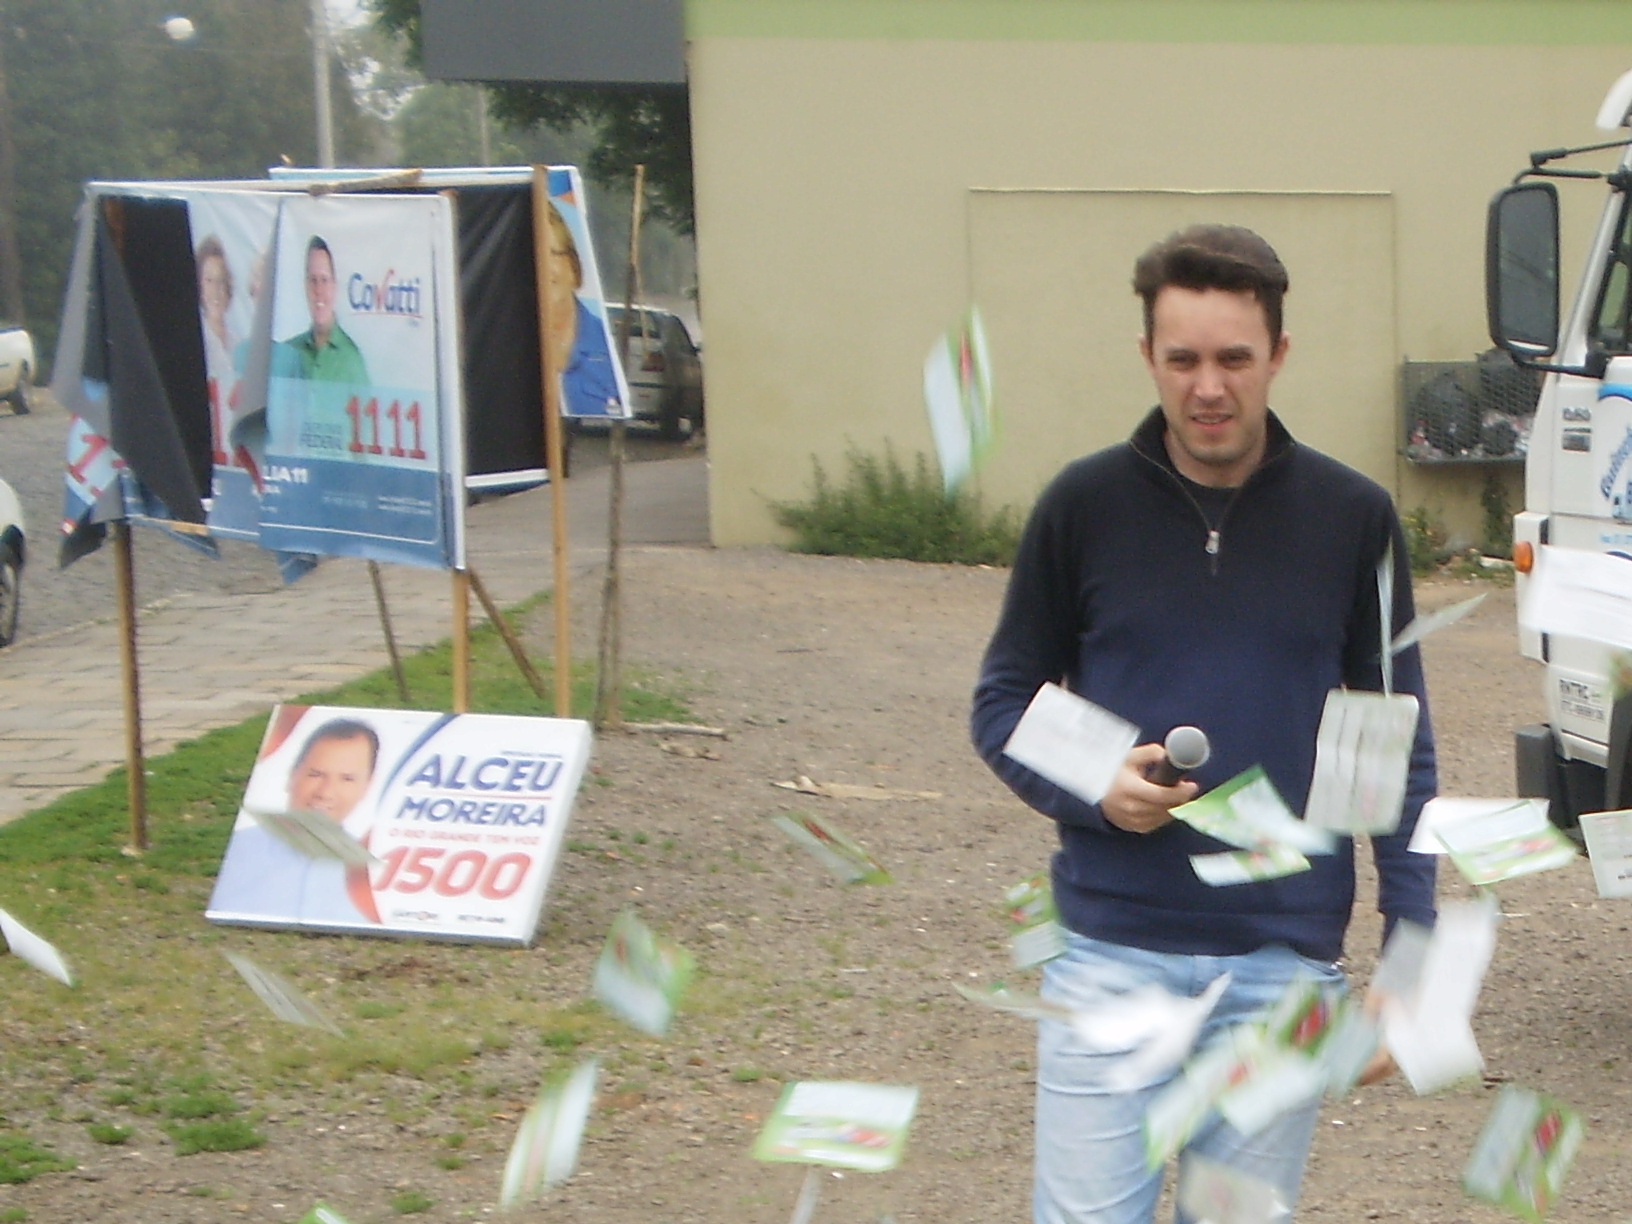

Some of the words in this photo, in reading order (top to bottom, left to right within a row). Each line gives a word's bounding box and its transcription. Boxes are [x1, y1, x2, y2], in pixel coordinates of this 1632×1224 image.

[347, 269, 421, 314] Covatti
[346, 396, 427, 460] 1111
[406, 753, 563, 791] ALCEU
[396, 795, 546, 827] MOREIRA
[374, 846, 531, 900] 1500
